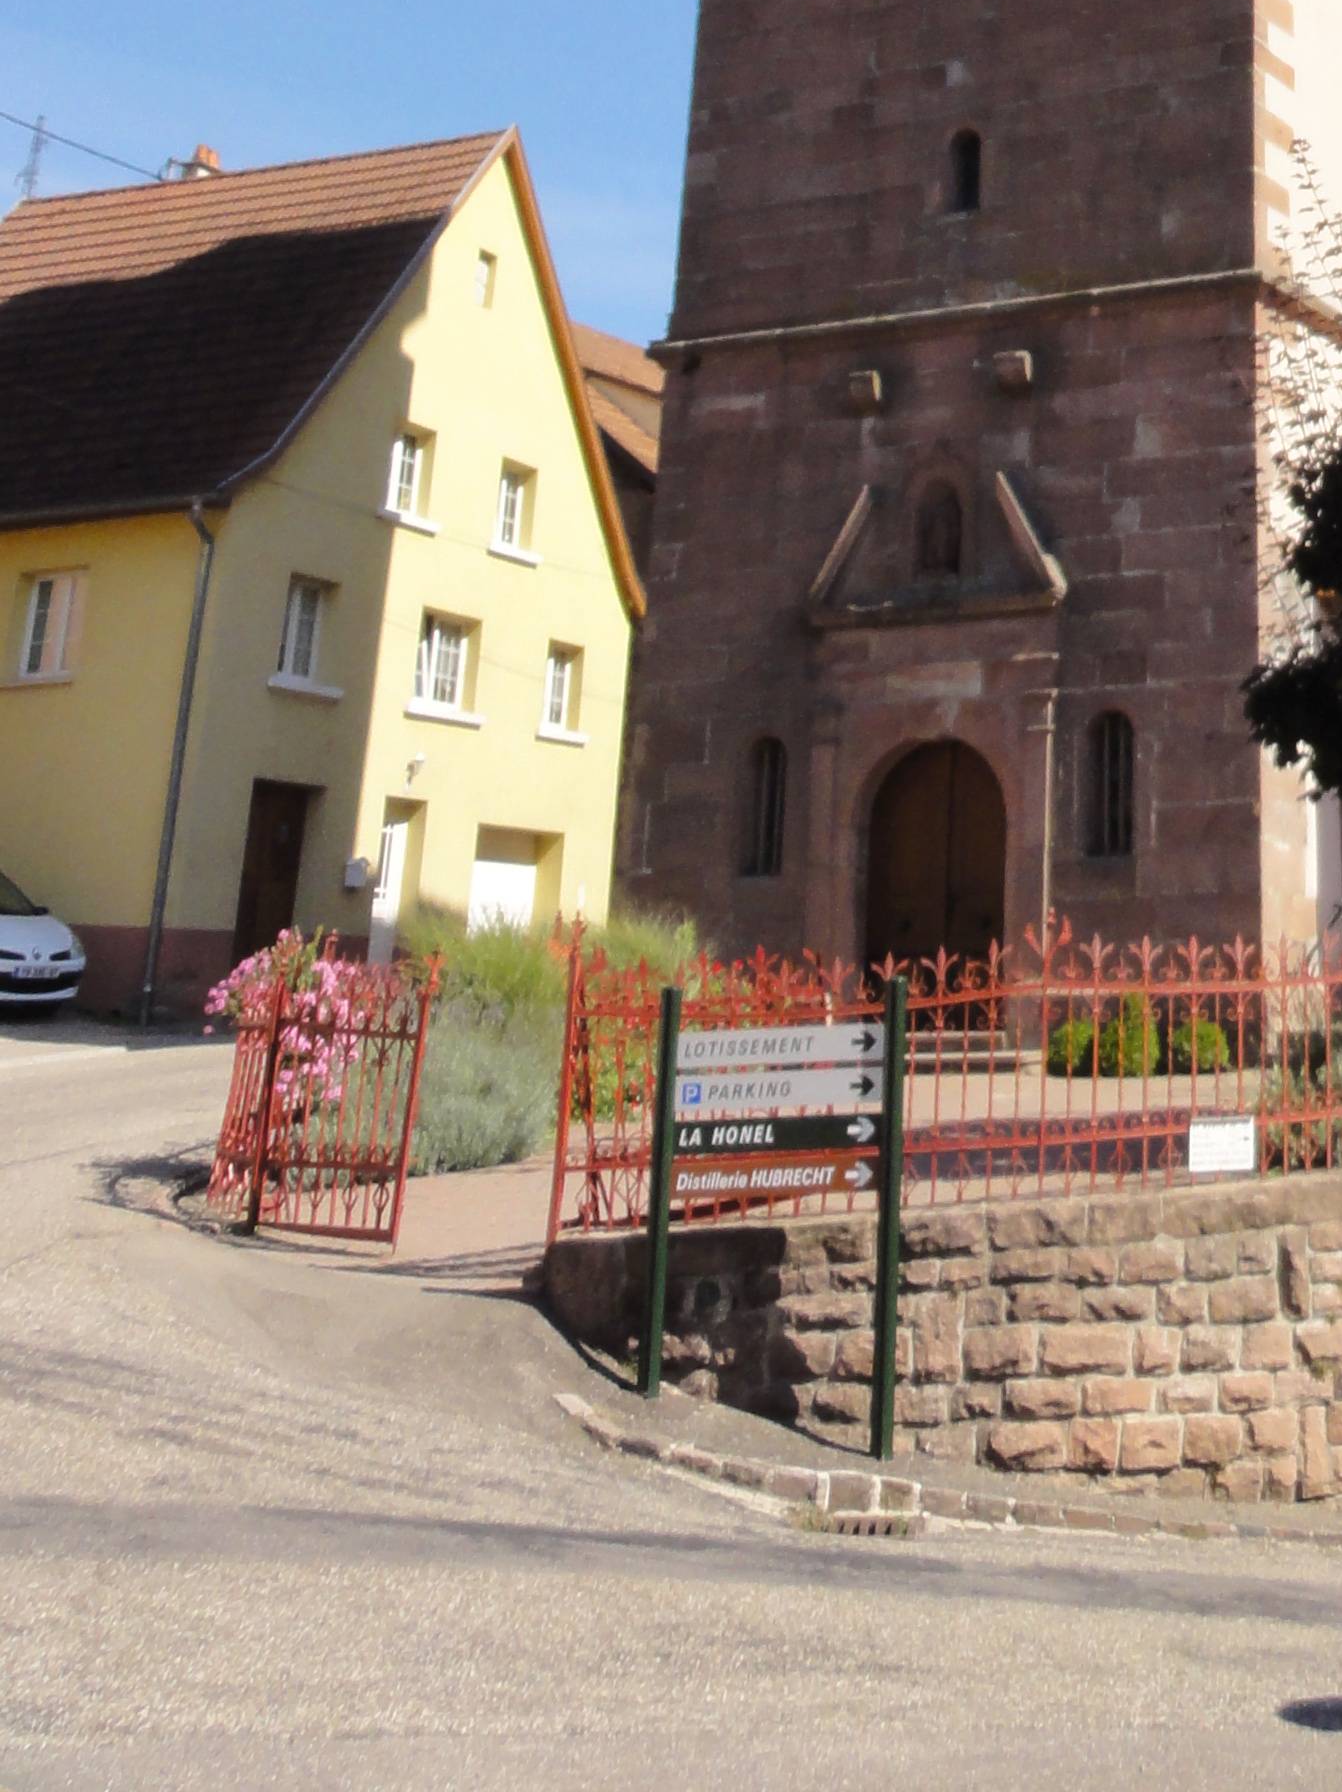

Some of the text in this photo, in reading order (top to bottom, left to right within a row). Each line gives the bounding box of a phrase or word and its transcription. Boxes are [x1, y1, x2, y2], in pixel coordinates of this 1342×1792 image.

[684, 1036, 814, 1058] LOTISSEMENT
[707, 1081, 792, 1100] PARKING
[679, 1125, 775, 1147] LA HONEL
[676, 1166, 835, 1191] Distillerie HUBRECHT
